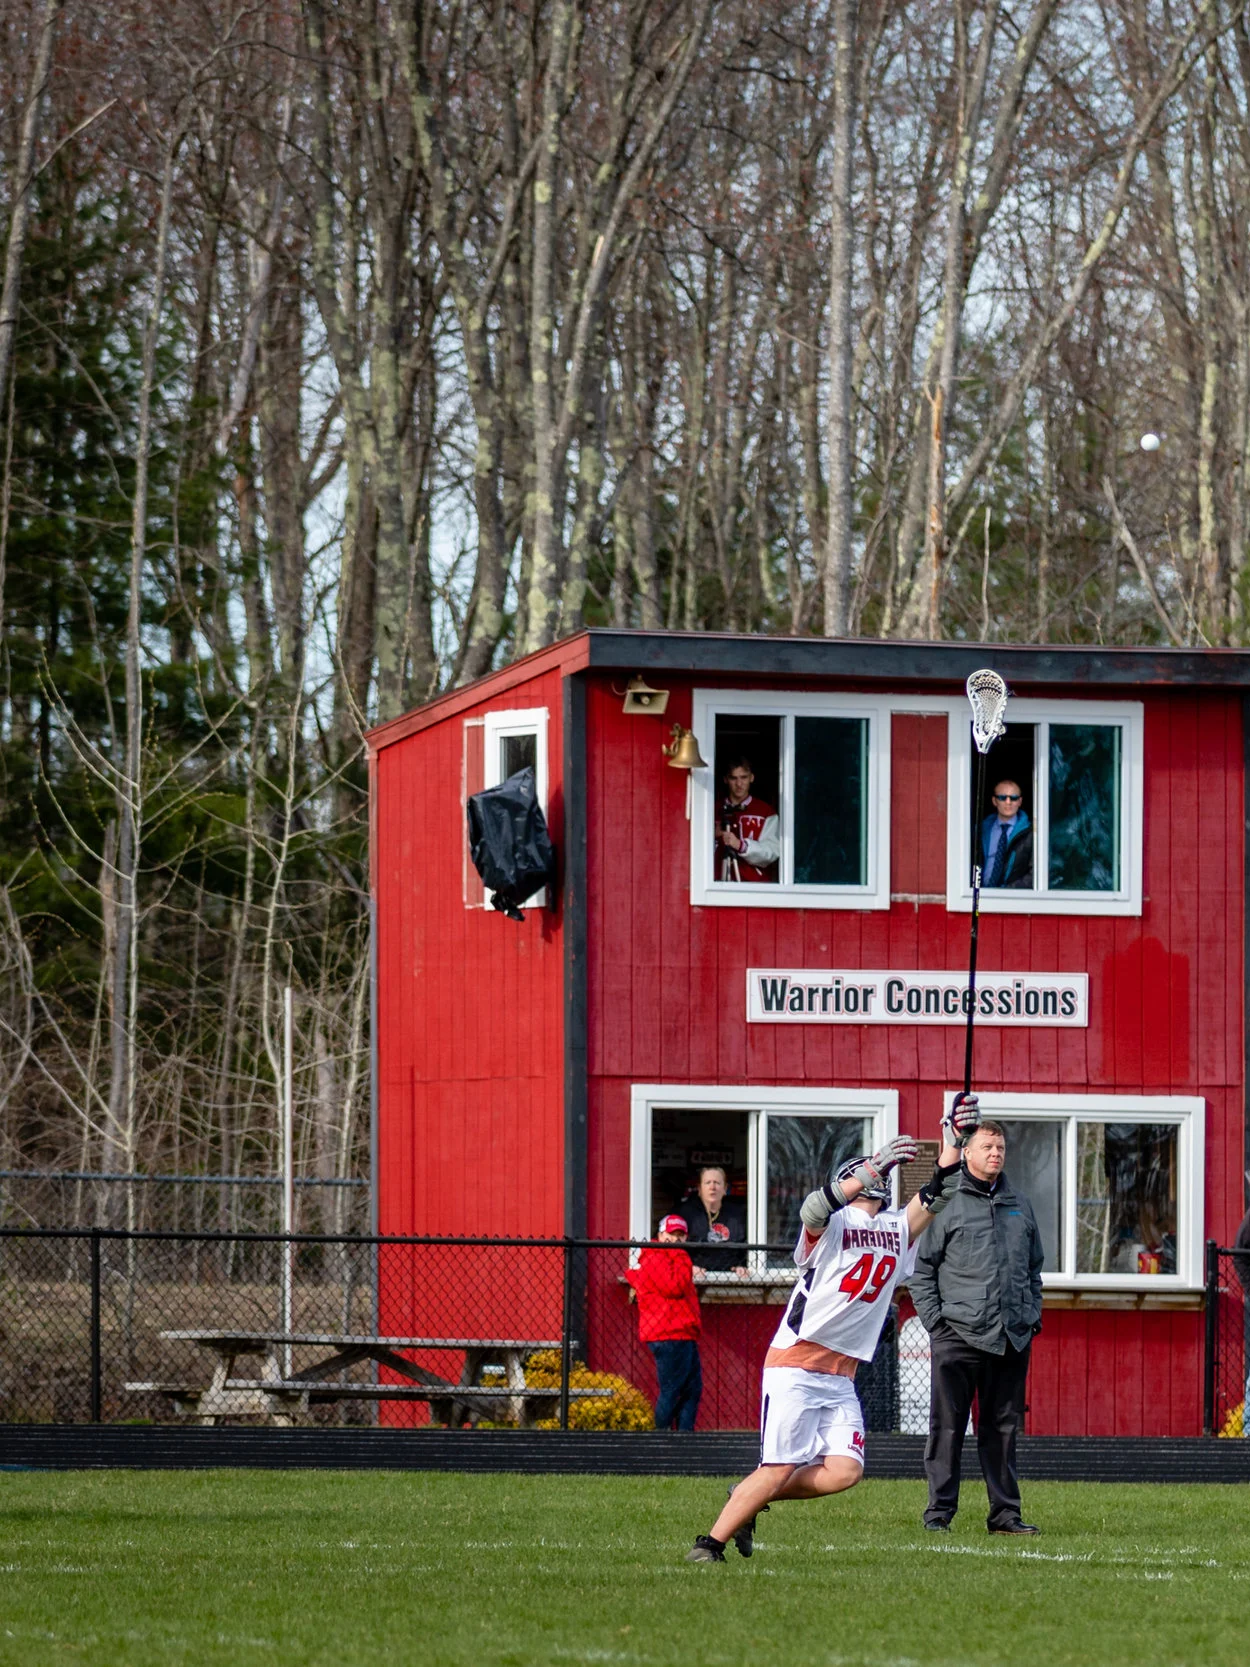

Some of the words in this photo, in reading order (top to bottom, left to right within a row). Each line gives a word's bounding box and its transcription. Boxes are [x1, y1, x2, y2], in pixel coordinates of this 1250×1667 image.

[759, 977, 876, 1015] Warrior
[886, 978, 1078, 1018] Concessions
[838, 1253, 897, 1304] 49
